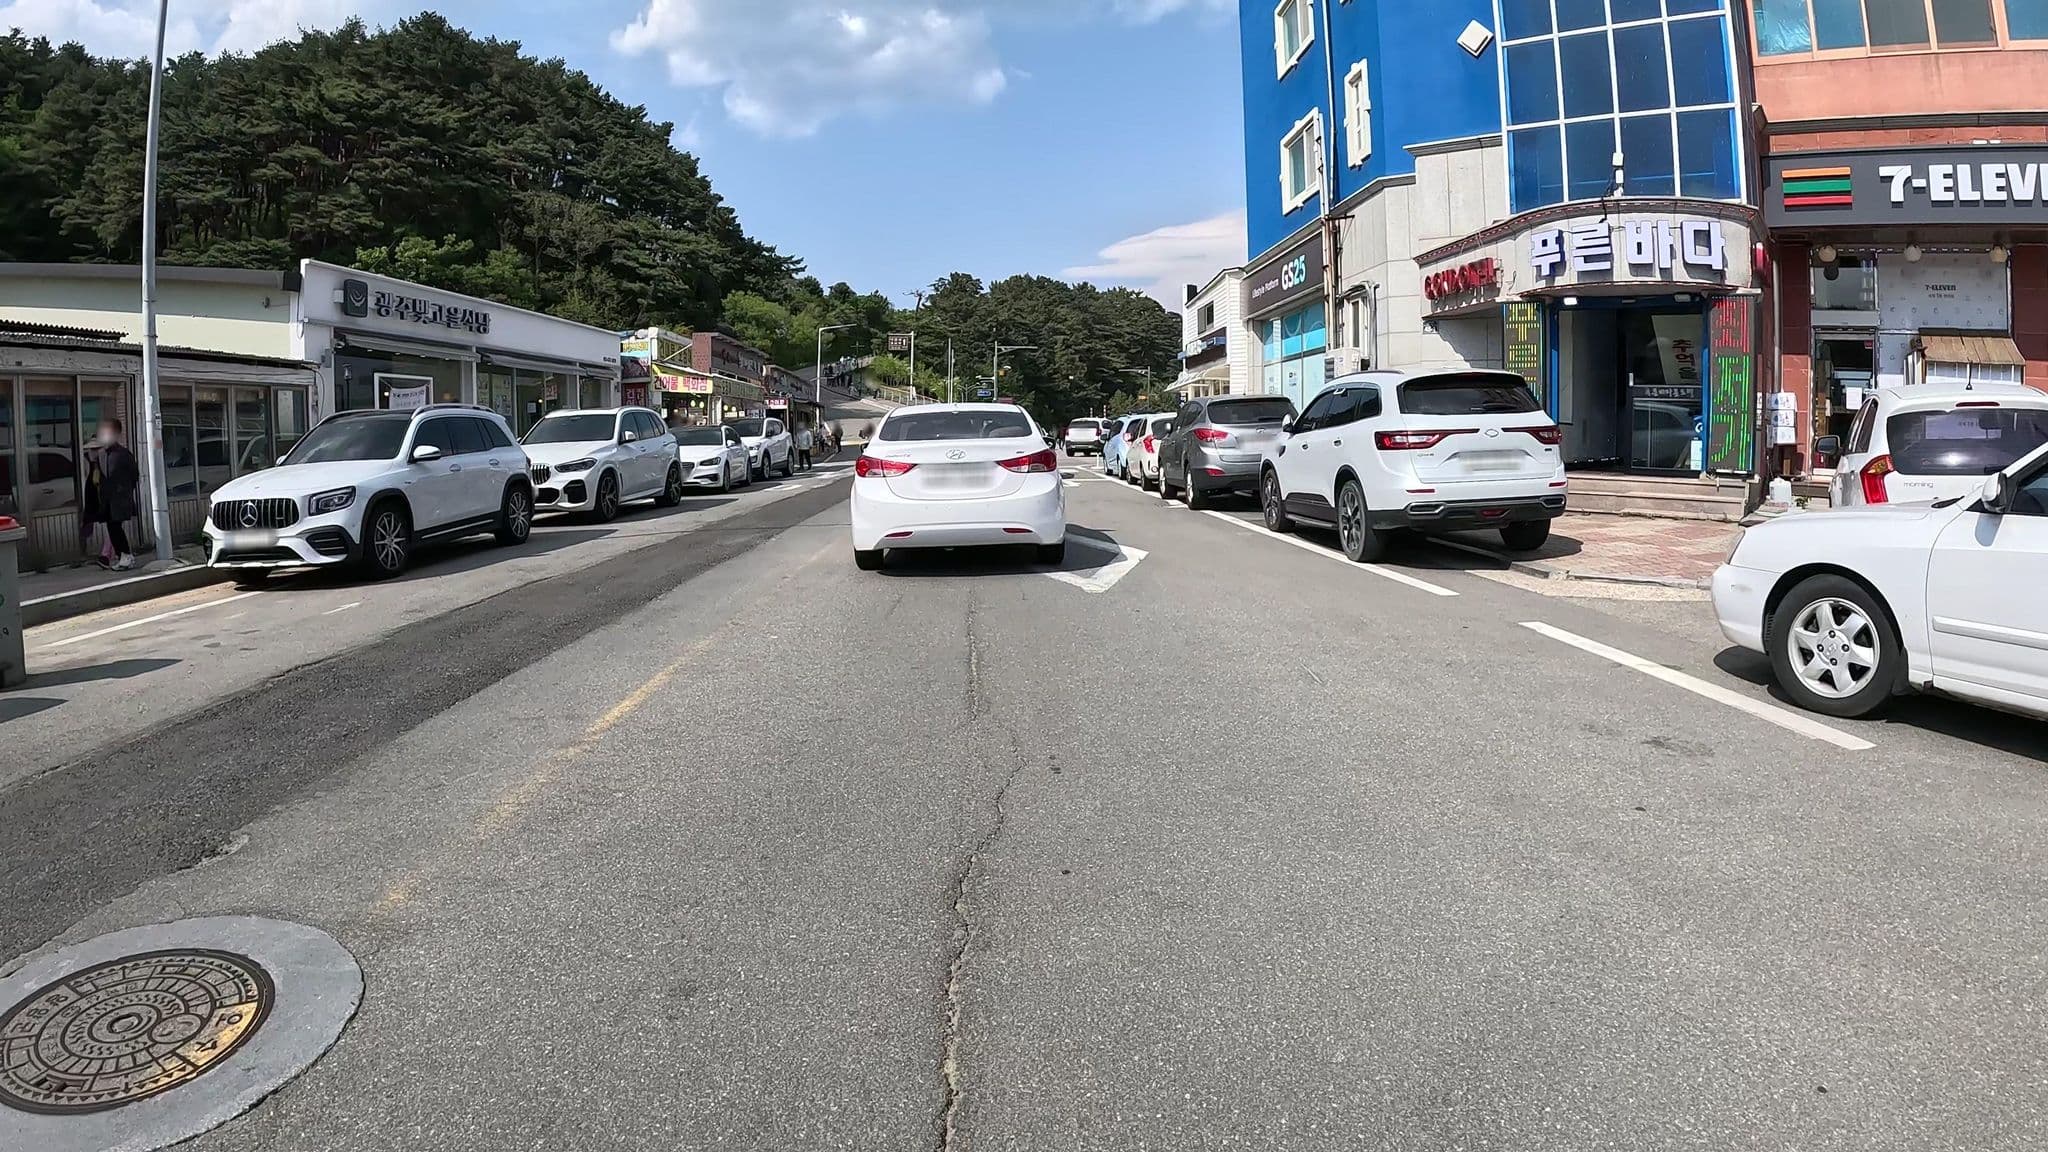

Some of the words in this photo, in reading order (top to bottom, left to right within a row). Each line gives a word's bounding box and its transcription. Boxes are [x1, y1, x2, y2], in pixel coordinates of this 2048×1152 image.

[1531, 221, 1726, 276] 푸른바다
[1282, 255, 1306, 290] GS25
[654, 375, 679, 391] 건어물
[683, 375, 708, 392] 백화점
